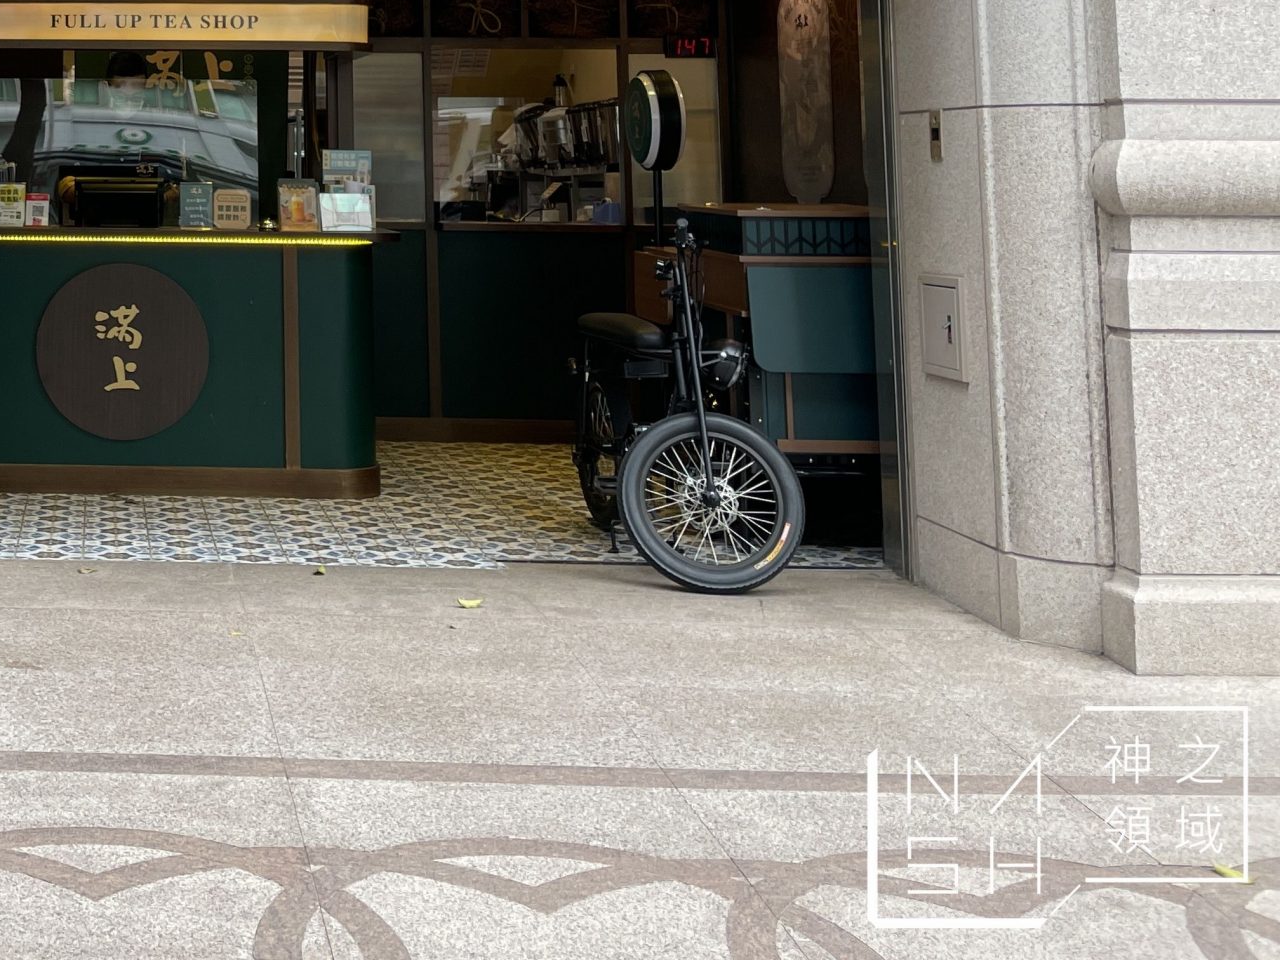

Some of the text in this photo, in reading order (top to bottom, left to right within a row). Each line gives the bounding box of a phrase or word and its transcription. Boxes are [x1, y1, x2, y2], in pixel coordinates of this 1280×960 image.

[50, 14, 259, 30] FULL UP TEA SHOP
[94, 304, 143, 391] 滿上
